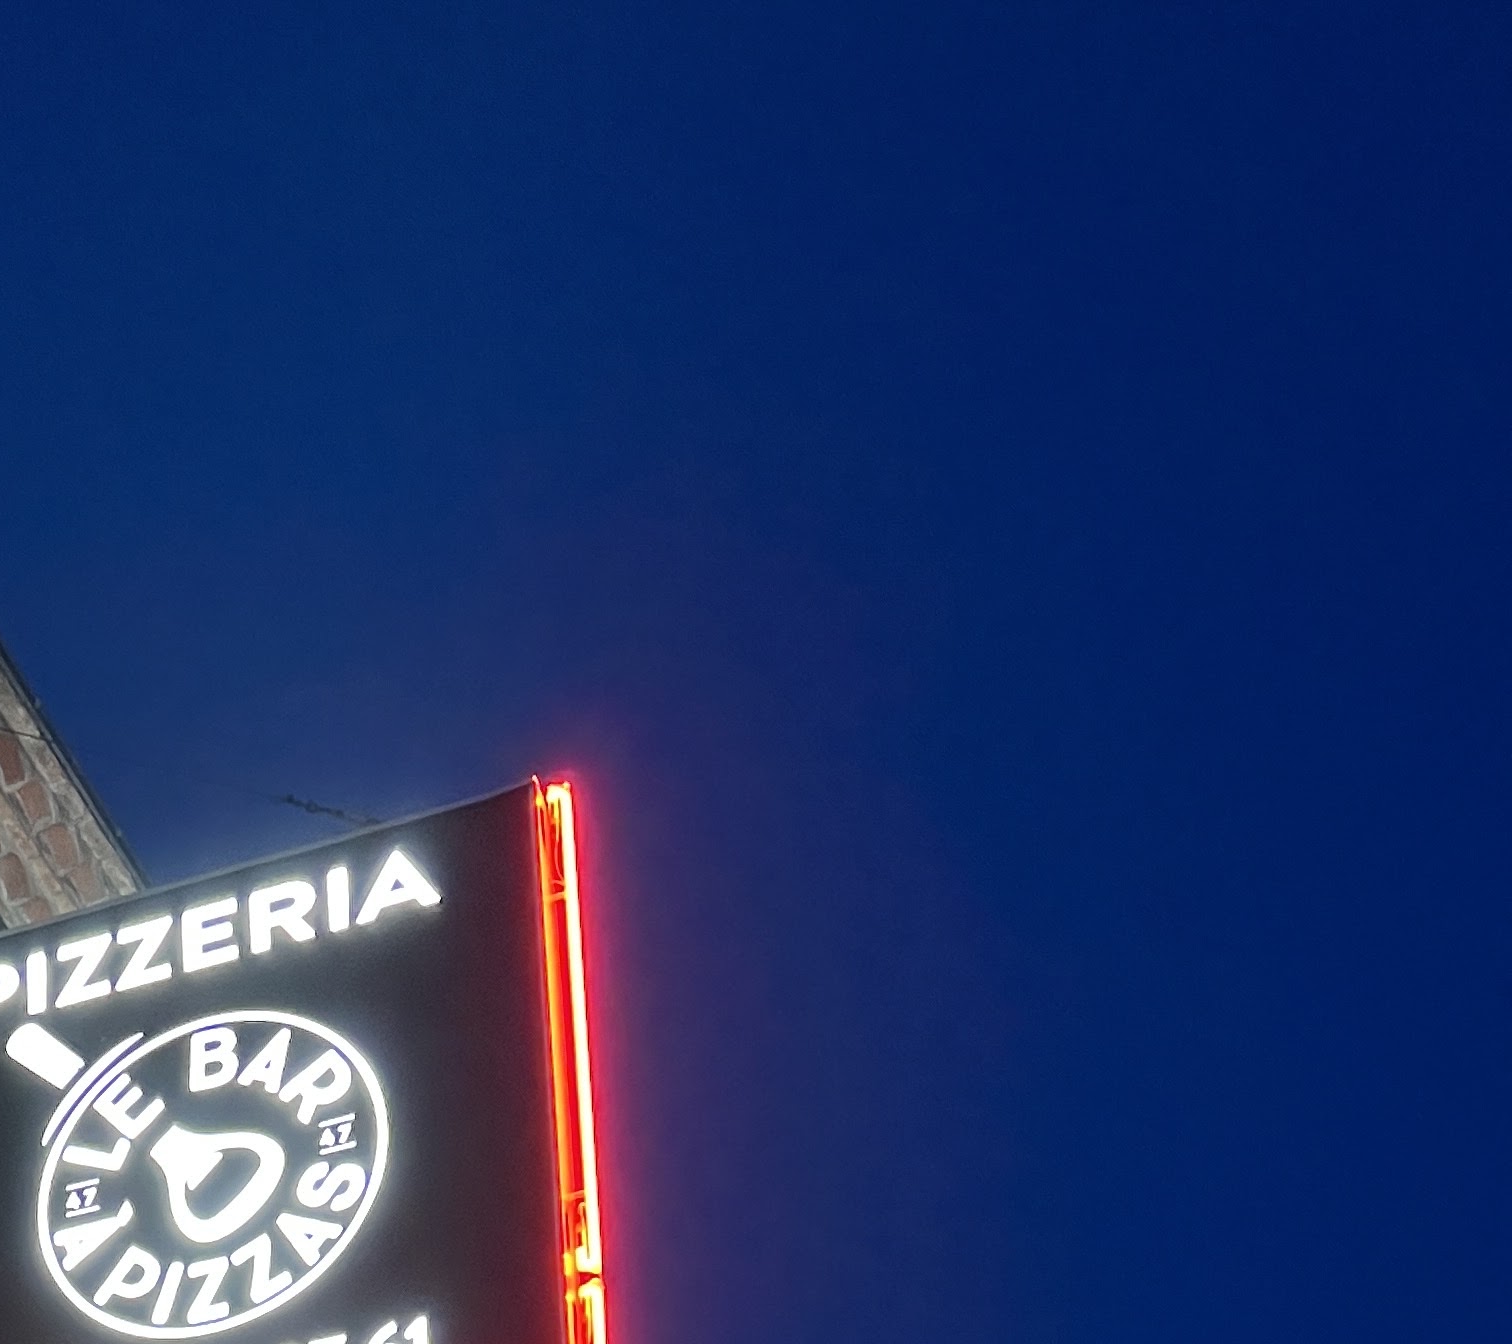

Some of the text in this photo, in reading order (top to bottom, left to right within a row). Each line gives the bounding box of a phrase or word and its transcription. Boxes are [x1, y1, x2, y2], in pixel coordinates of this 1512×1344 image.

[62, 1027, 352, 1171] LE BAR
[93, 1161, 366, 1325] PIZZAS
